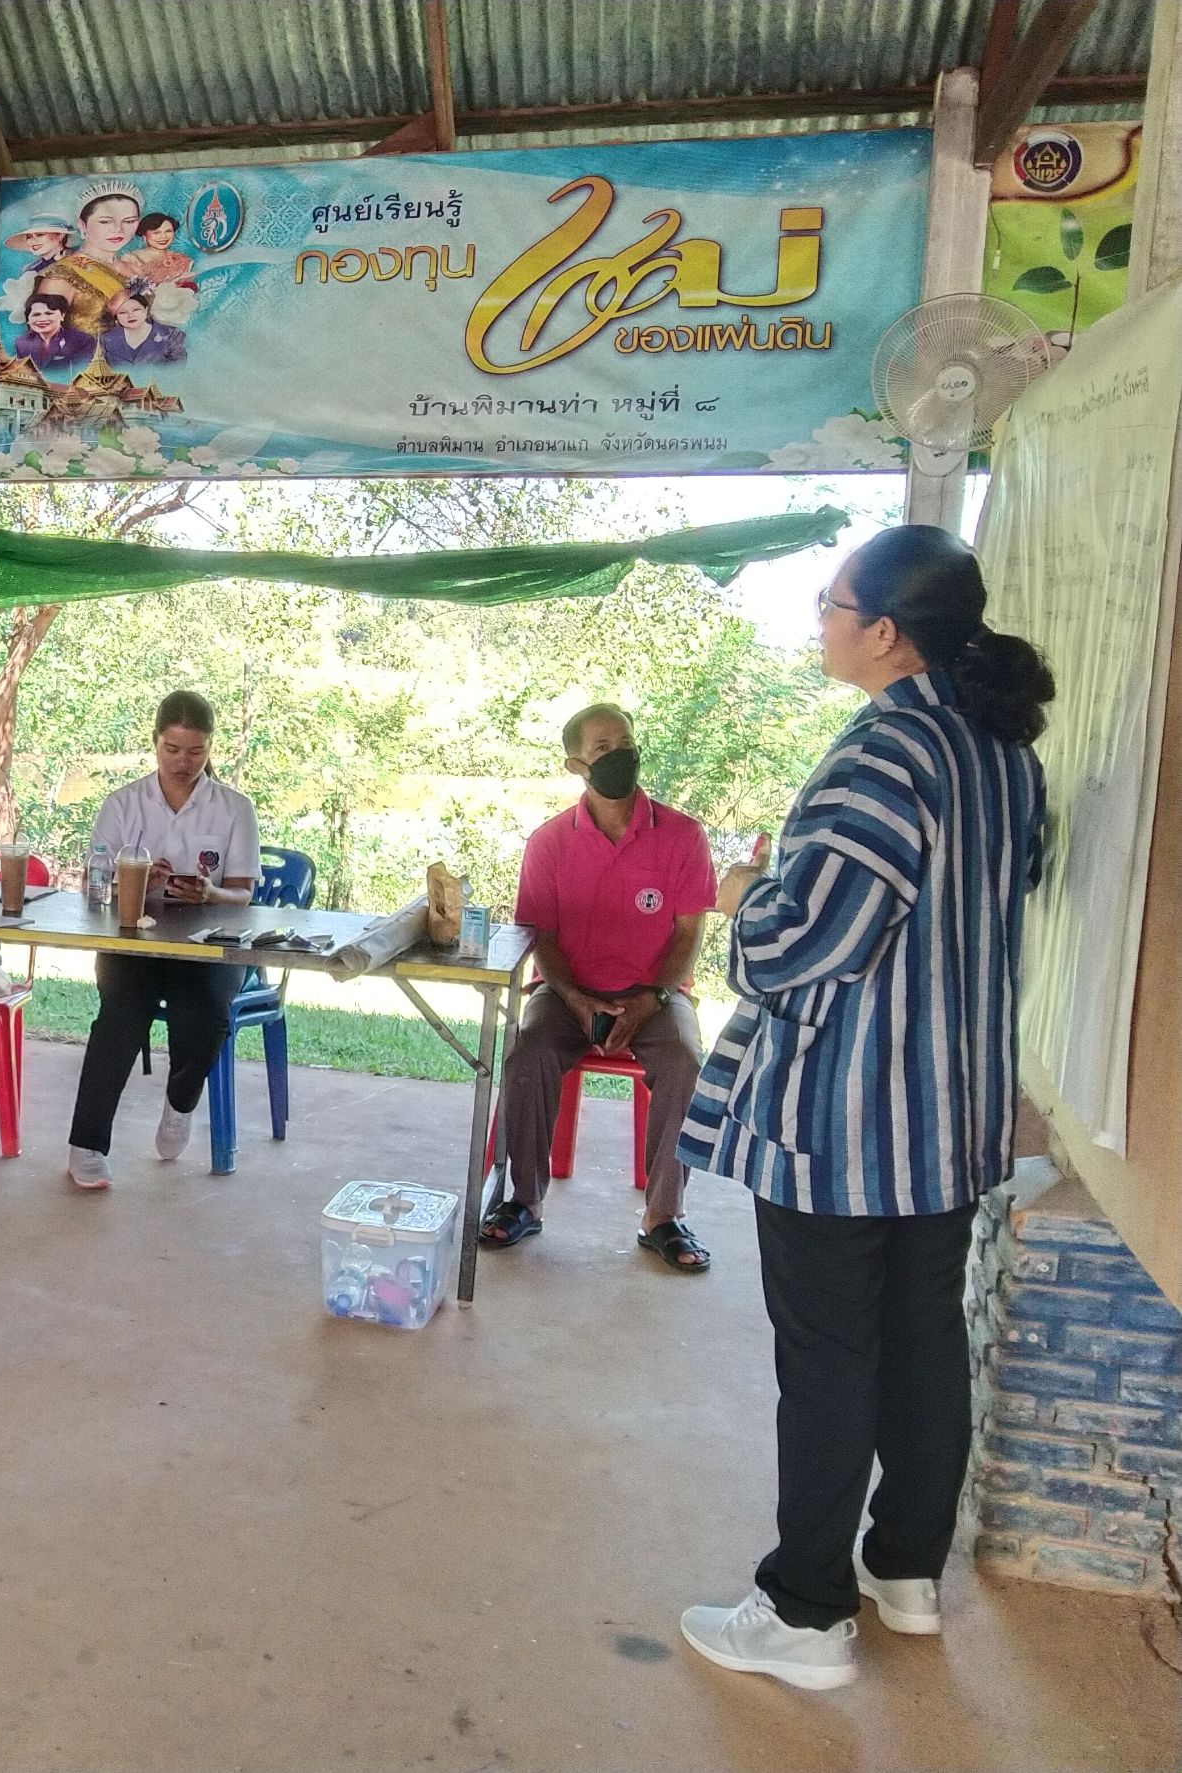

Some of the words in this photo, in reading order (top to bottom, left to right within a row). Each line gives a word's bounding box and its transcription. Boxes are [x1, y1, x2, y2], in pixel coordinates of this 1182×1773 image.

[312, 189, 463, 233] ศูนย์เรียนรู้
[294, 243, 476, 292] กองทุน
[615, 314, 832, 353] ของแผ่นดิน
[409, 392, 598, 416] บ้านพิมานท่า
[612, 384, 681, 421] หมู่ที่
[695, 396, 720, 412] ๘
[396, 435, 484, 454] ตำบลพิมาน
[496, 434, 589, 452] อำเภอนาแก
[600, 431, 728, 451] จังหวัดนครพนม
